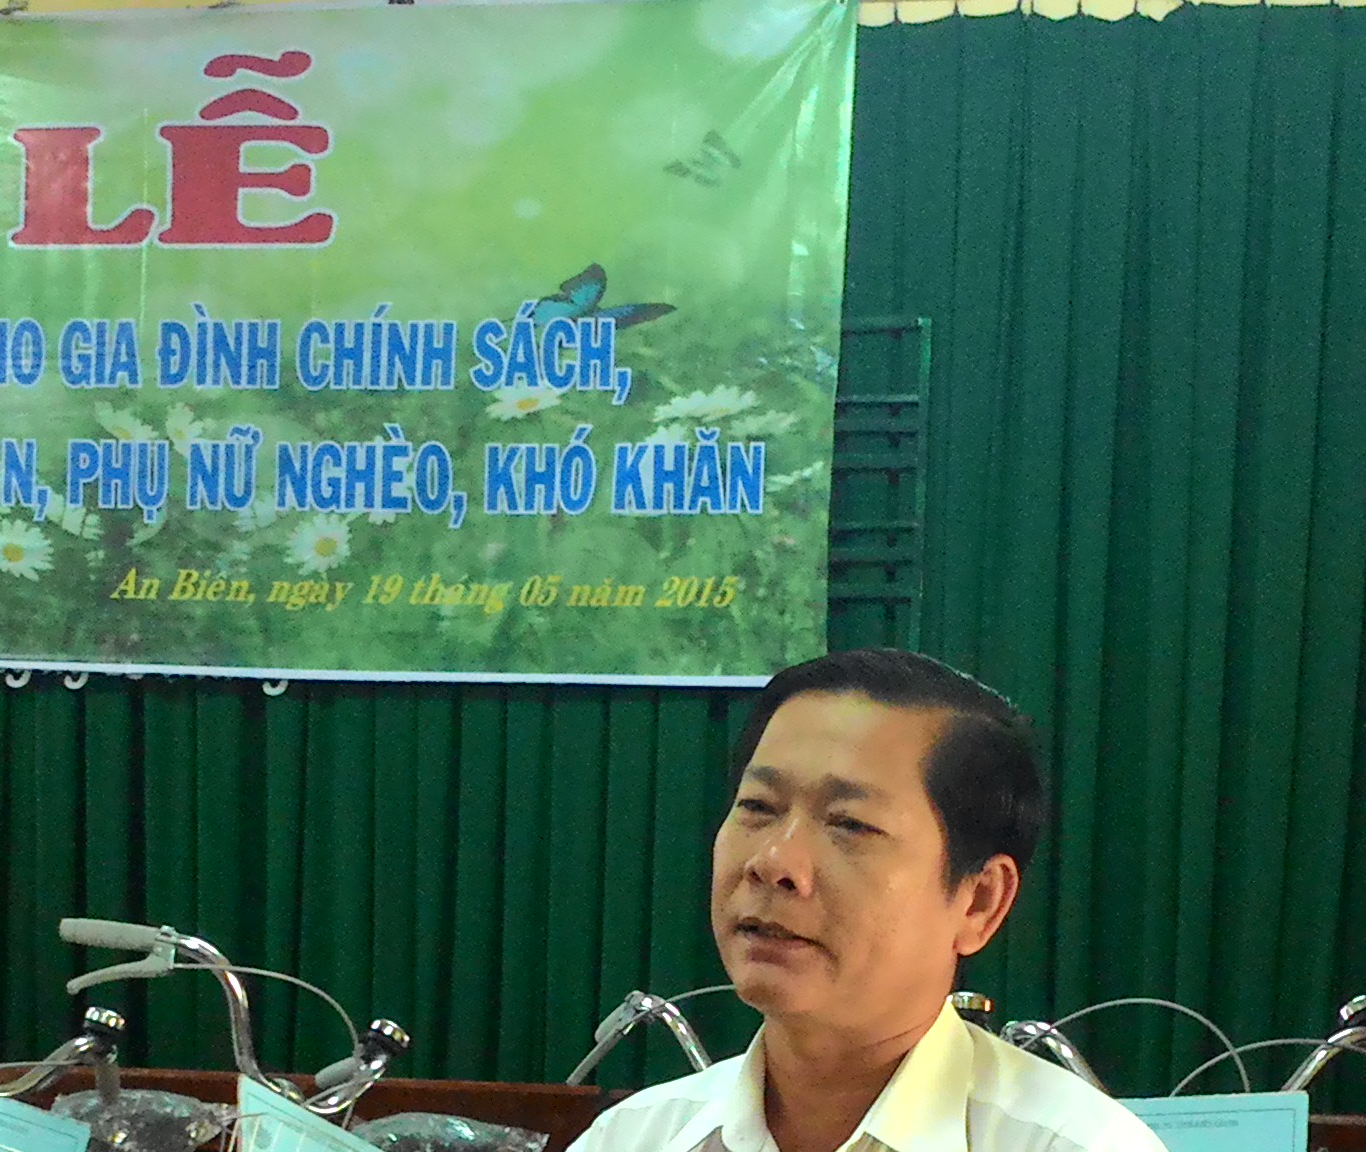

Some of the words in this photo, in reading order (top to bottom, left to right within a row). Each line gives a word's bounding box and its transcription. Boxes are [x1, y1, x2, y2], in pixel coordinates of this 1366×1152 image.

[9, 48, 337, 248] LỄ
[59, 318, 141, 388] GIA
[157, 302, 281, 391] ĐÌNH
[296, 302, 457, 391] CHÍNH
[472, 301, 632, 405] SÁCH,
[67, 438, 169, 524] PHỤ
[186, 424, 263, 511] NỮ
[275, 423, 468, 529] NGHÈO,
[484, 423, 597, 514] KHÓ
[611, 427, 766, 514] KHĂN
[110, 567, 161, 600] An
[363, 574, 405, 604] 19
[519, 575, 563, 607] 05
[654, 576, 740, 608] 2015
